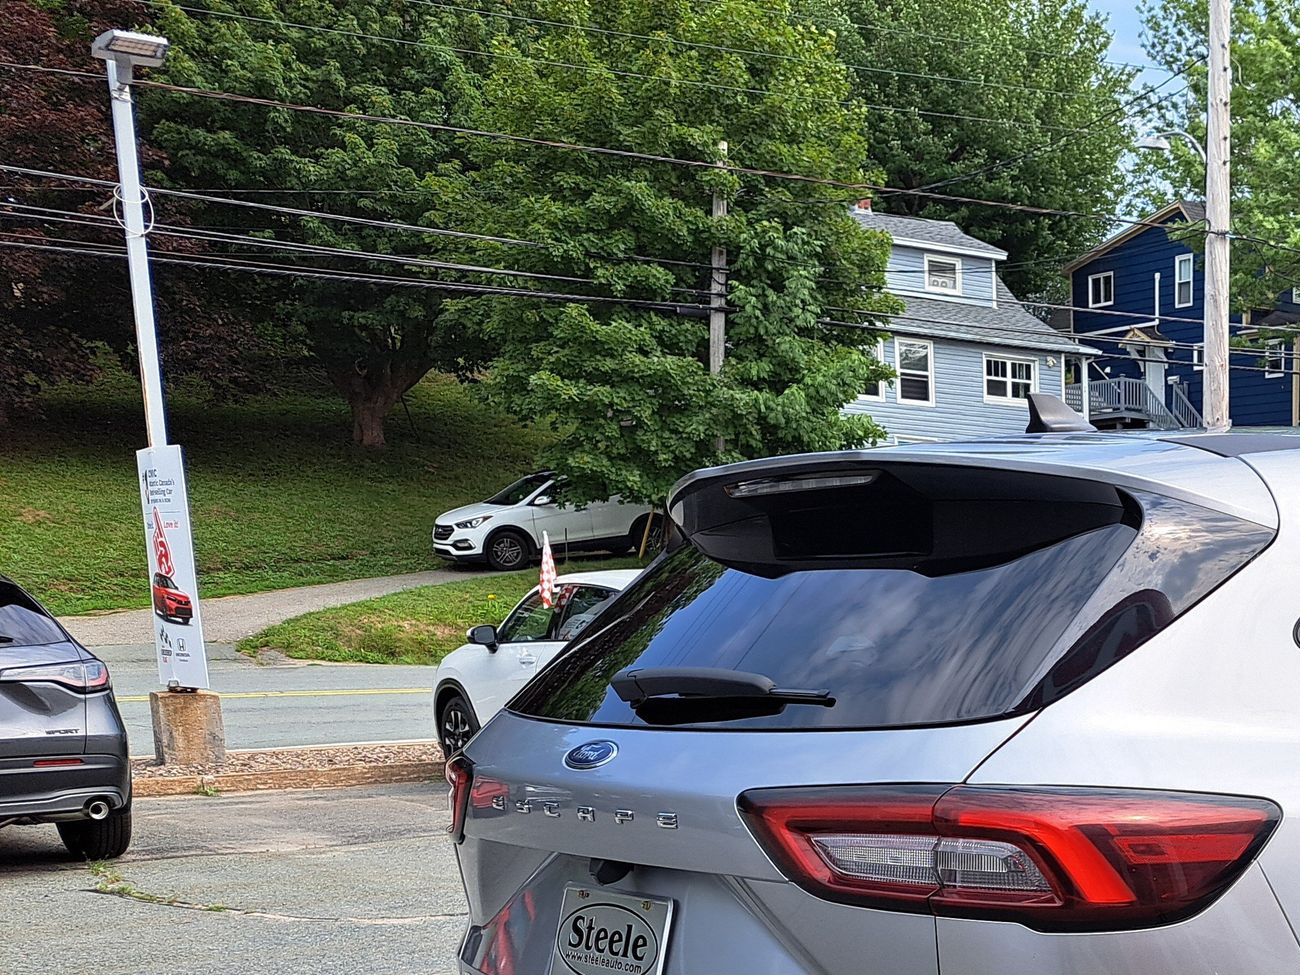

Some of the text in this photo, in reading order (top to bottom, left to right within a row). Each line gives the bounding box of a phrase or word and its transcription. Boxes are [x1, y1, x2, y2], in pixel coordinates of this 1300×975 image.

[491, 795, 681, 830] ESCAPE
[568, 914, 648, 962] Steele
[565, 949, 643, 975] www.steeleauto.com
